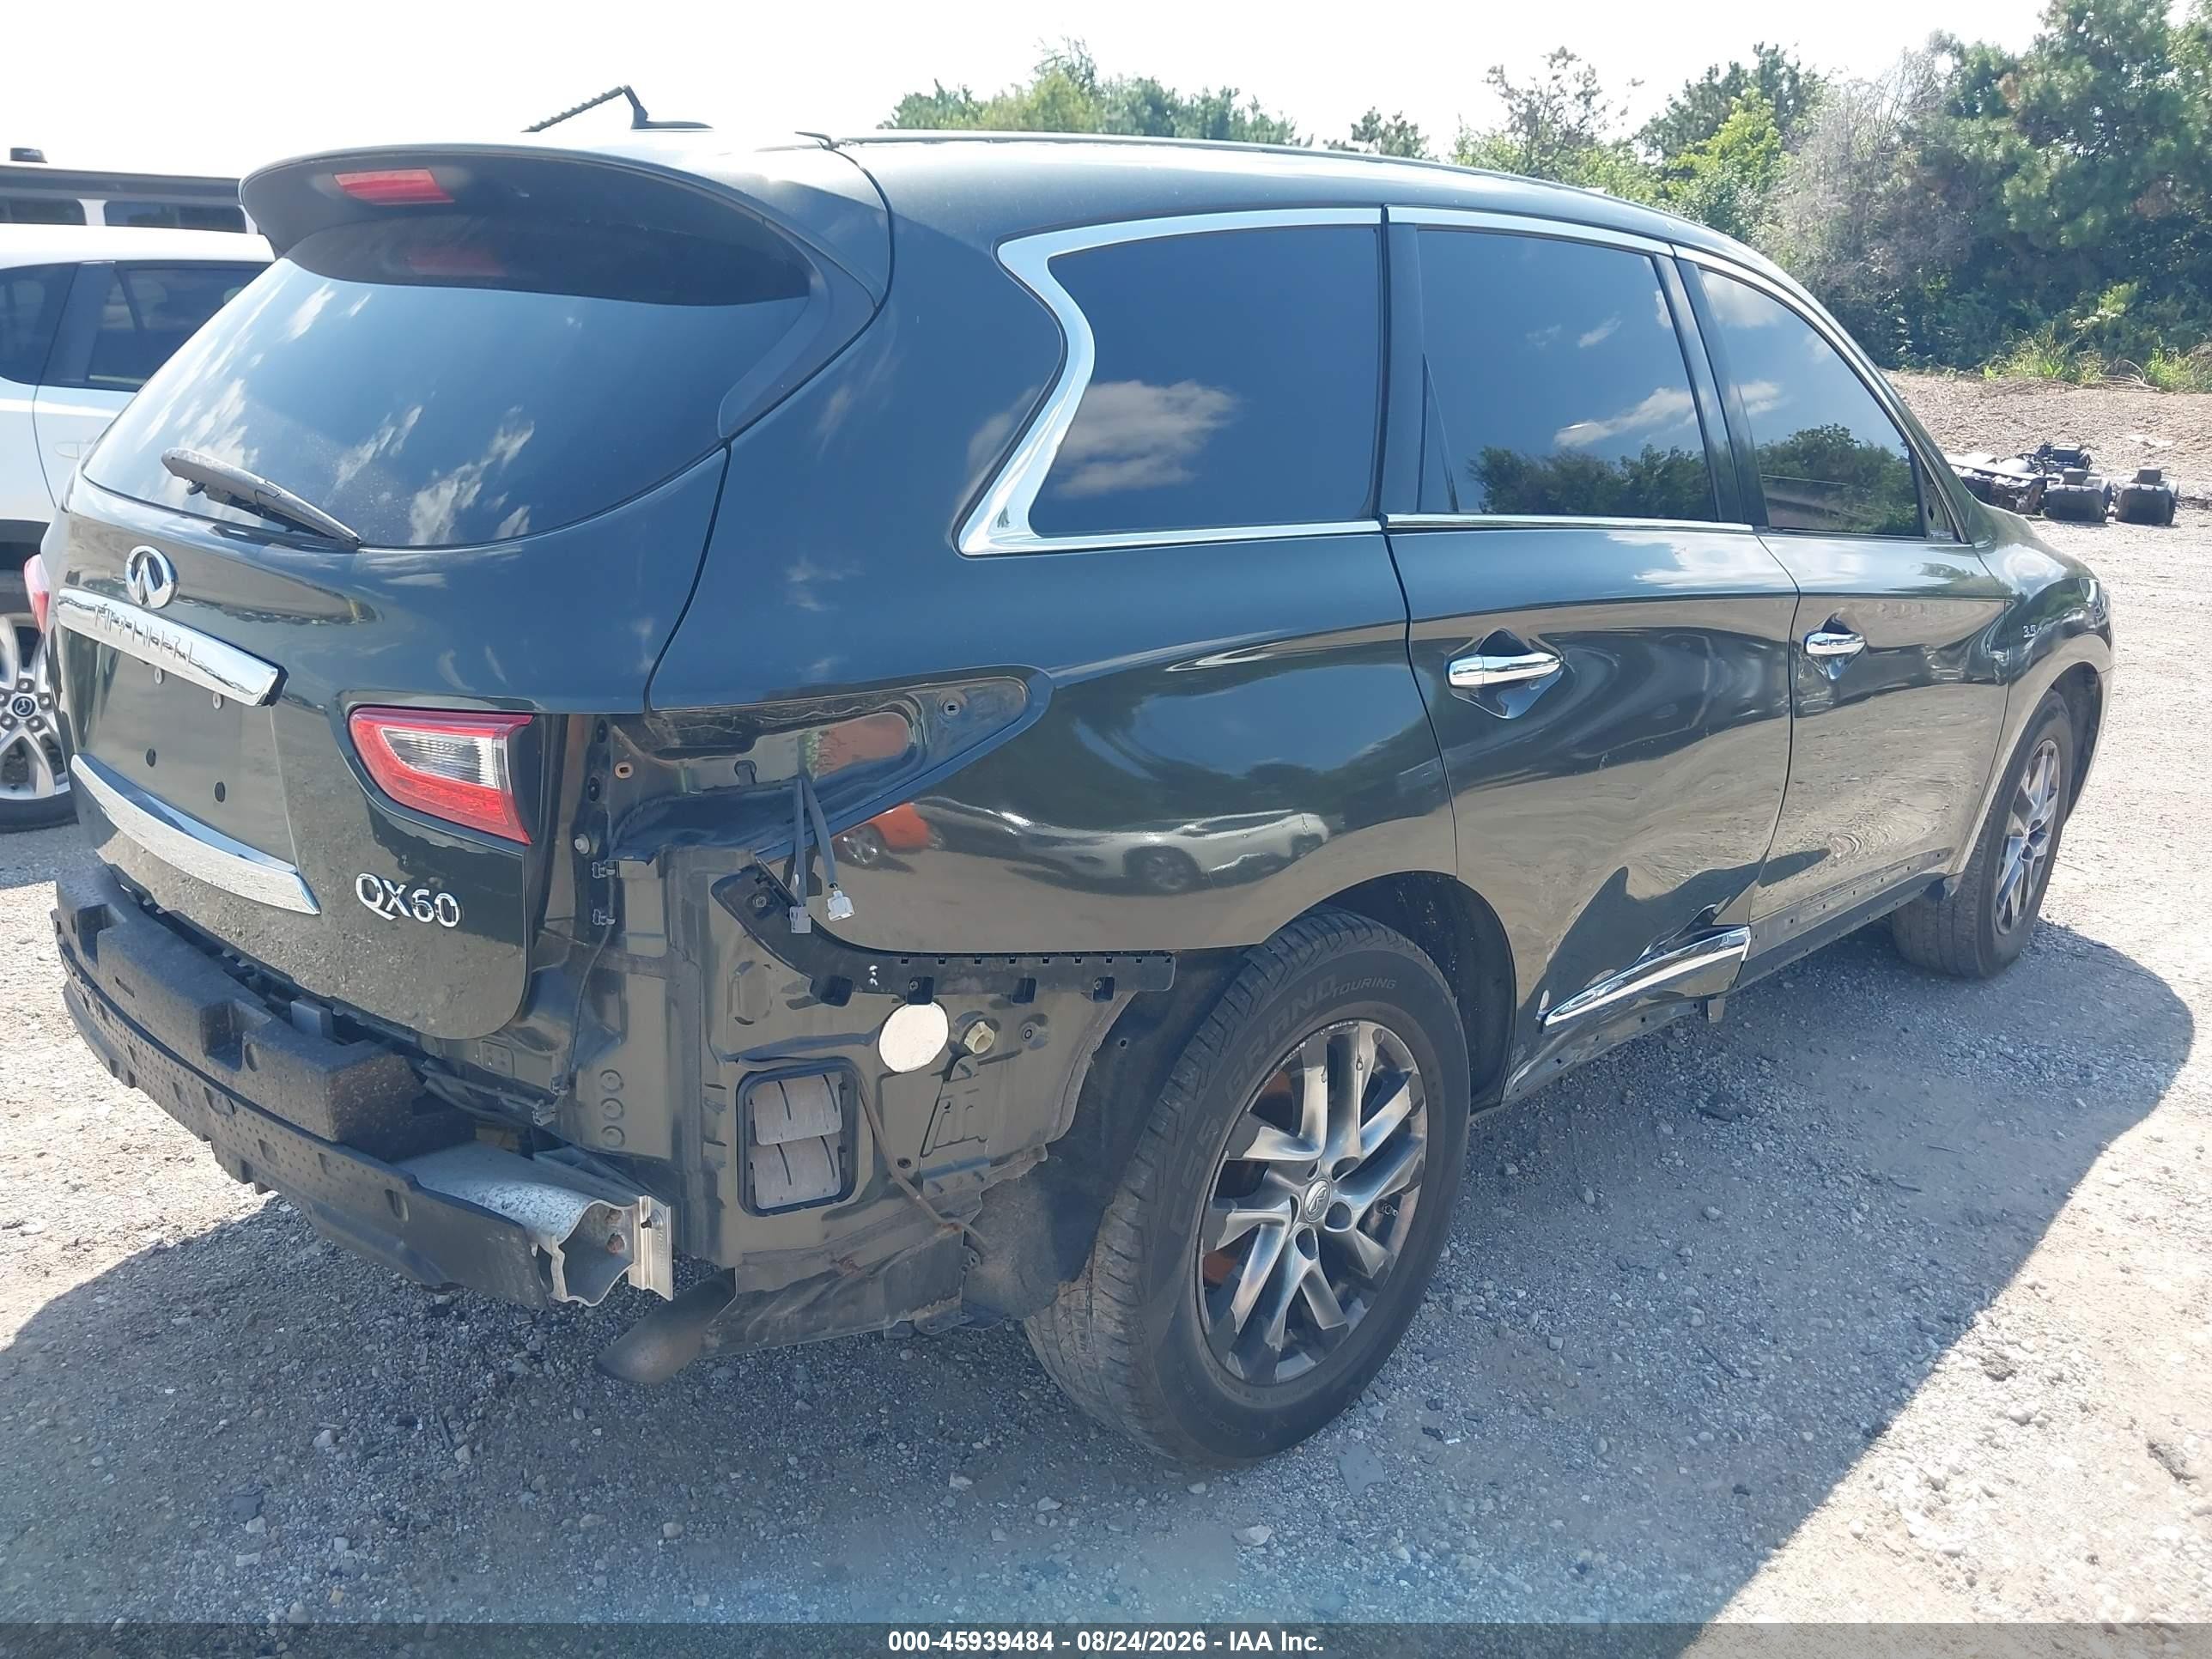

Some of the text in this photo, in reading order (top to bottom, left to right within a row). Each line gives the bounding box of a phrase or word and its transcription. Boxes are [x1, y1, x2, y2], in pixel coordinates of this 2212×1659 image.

[356, 872, 460, 927] QX60
[1224, 974, 1337, 1102] GRAND
[1331, 977, 1397, 999] TOURING
